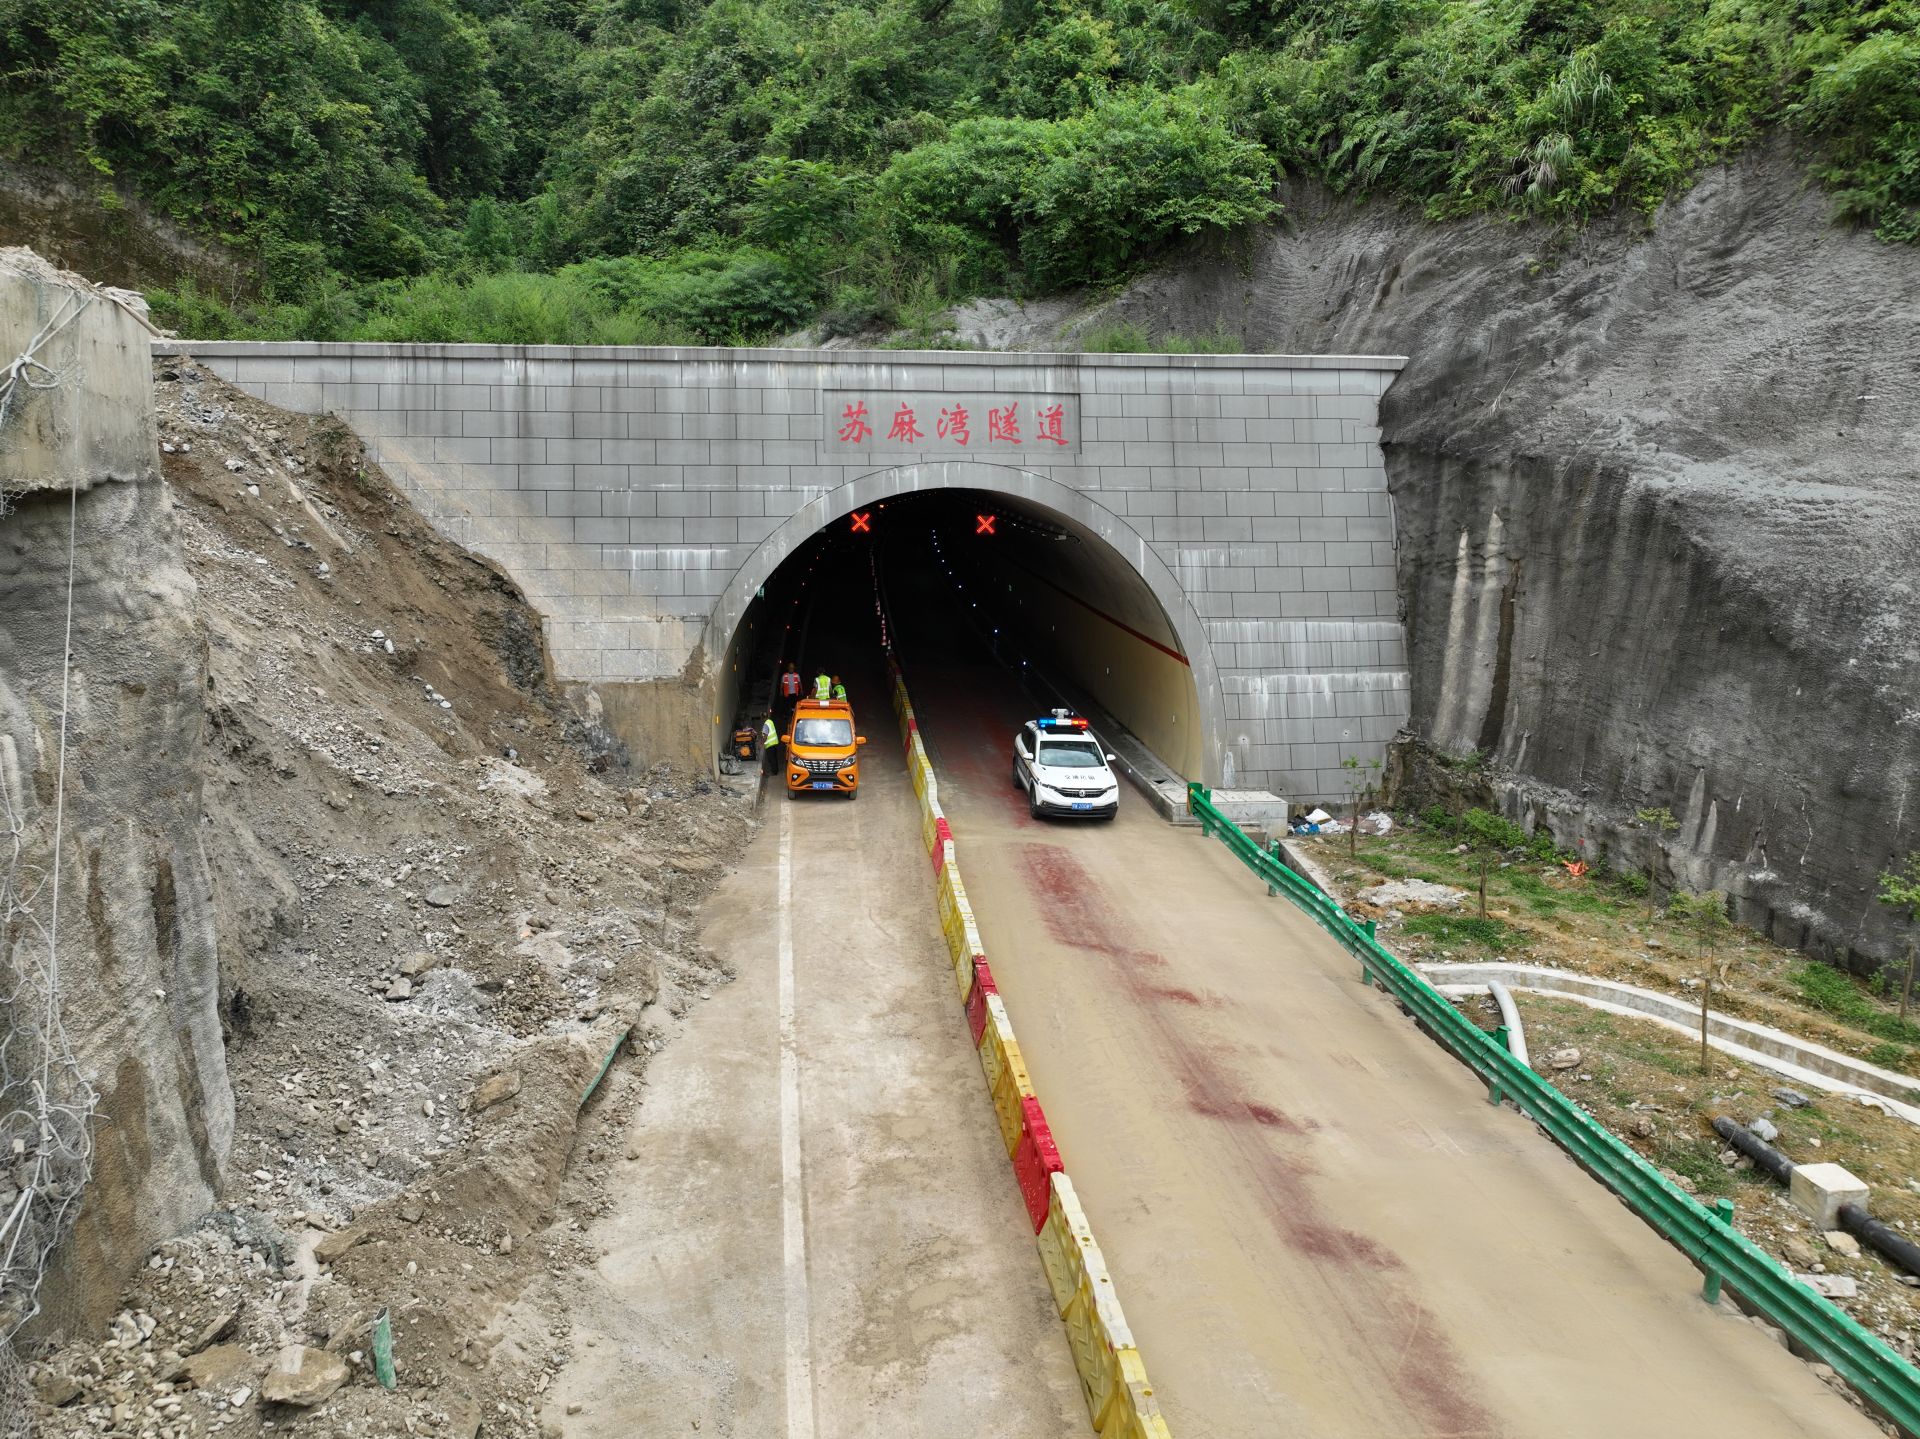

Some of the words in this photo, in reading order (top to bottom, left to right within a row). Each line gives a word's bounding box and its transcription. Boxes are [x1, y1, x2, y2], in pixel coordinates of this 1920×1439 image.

[838, 401, 1069, 446] 苏麻湾隧道
